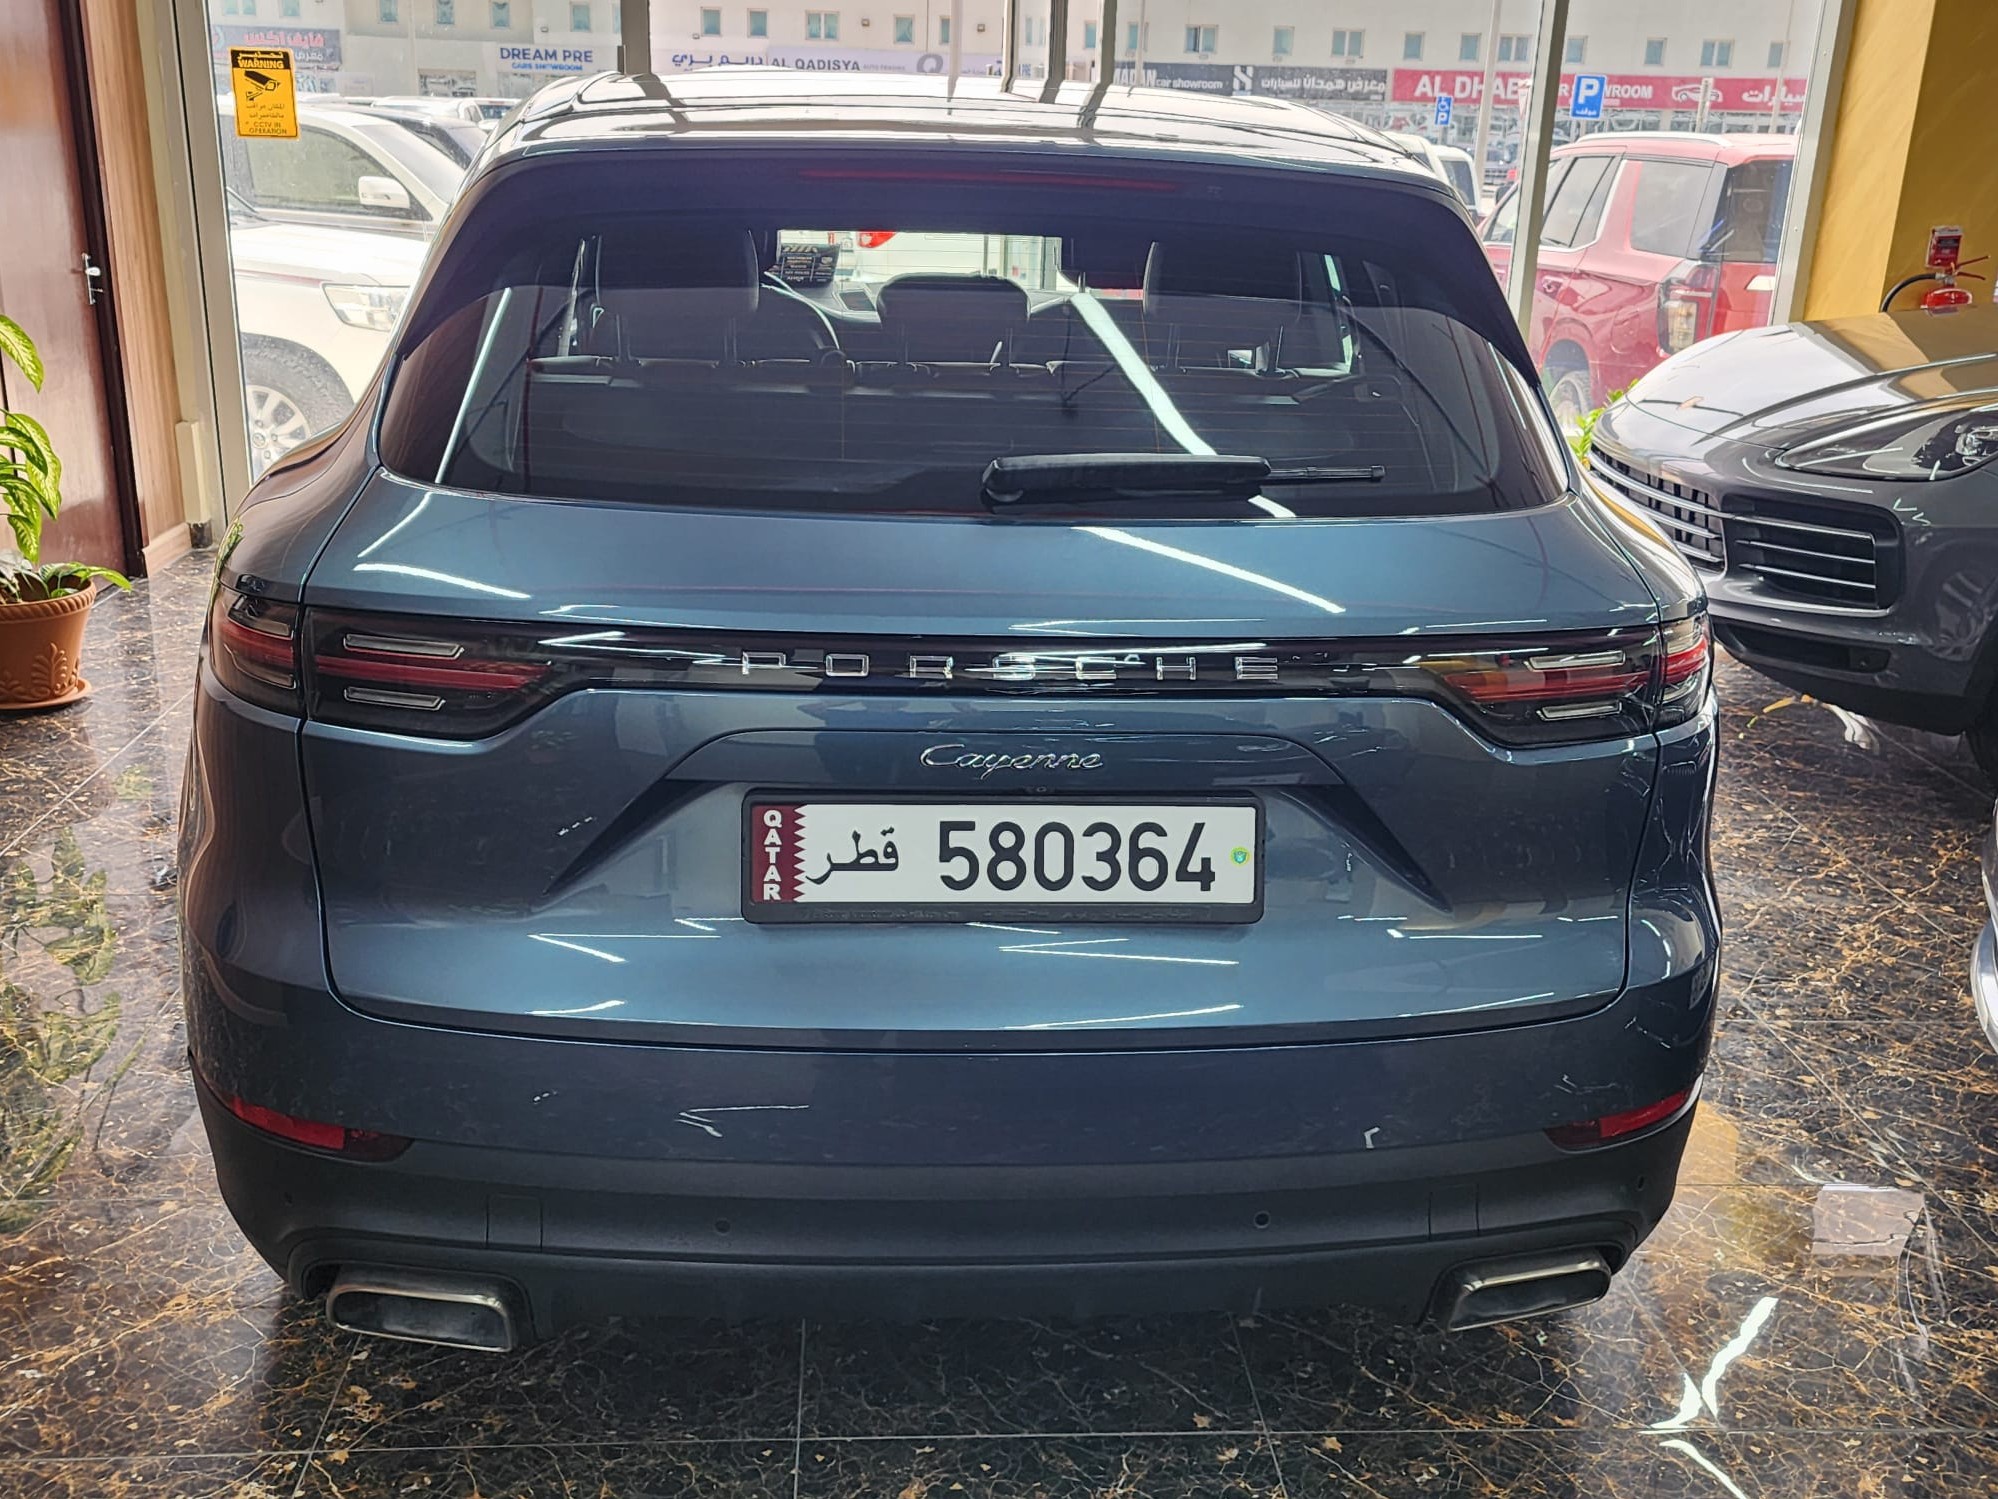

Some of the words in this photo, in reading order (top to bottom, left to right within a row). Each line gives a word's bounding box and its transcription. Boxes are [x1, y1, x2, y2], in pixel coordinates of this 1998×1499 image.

[237, 59, 284, 69] WARNING
[500, 47, 557, 61] DREAM
[562, 50, 593, 63] PRE
[795, 58, 860, 71] QADISYA
[1157, 79, 1171, 88] car
[1173, 78, 1223, 90] showroom
[1414, 74, 1448, 97] AL
[1454, 76, 1520, 99] DHAB
[1578, 77, 1600, 105] P
[1437, 112, 1448, 122] P
[742, 651, 1278, 681] PORSCHE
[920, 743, 1103, 780] Cayenne
[763, 809, 783, 900] QATAR
[805, 826, 899, 885] قطر
[939, 820, 1216, 892] 580364
